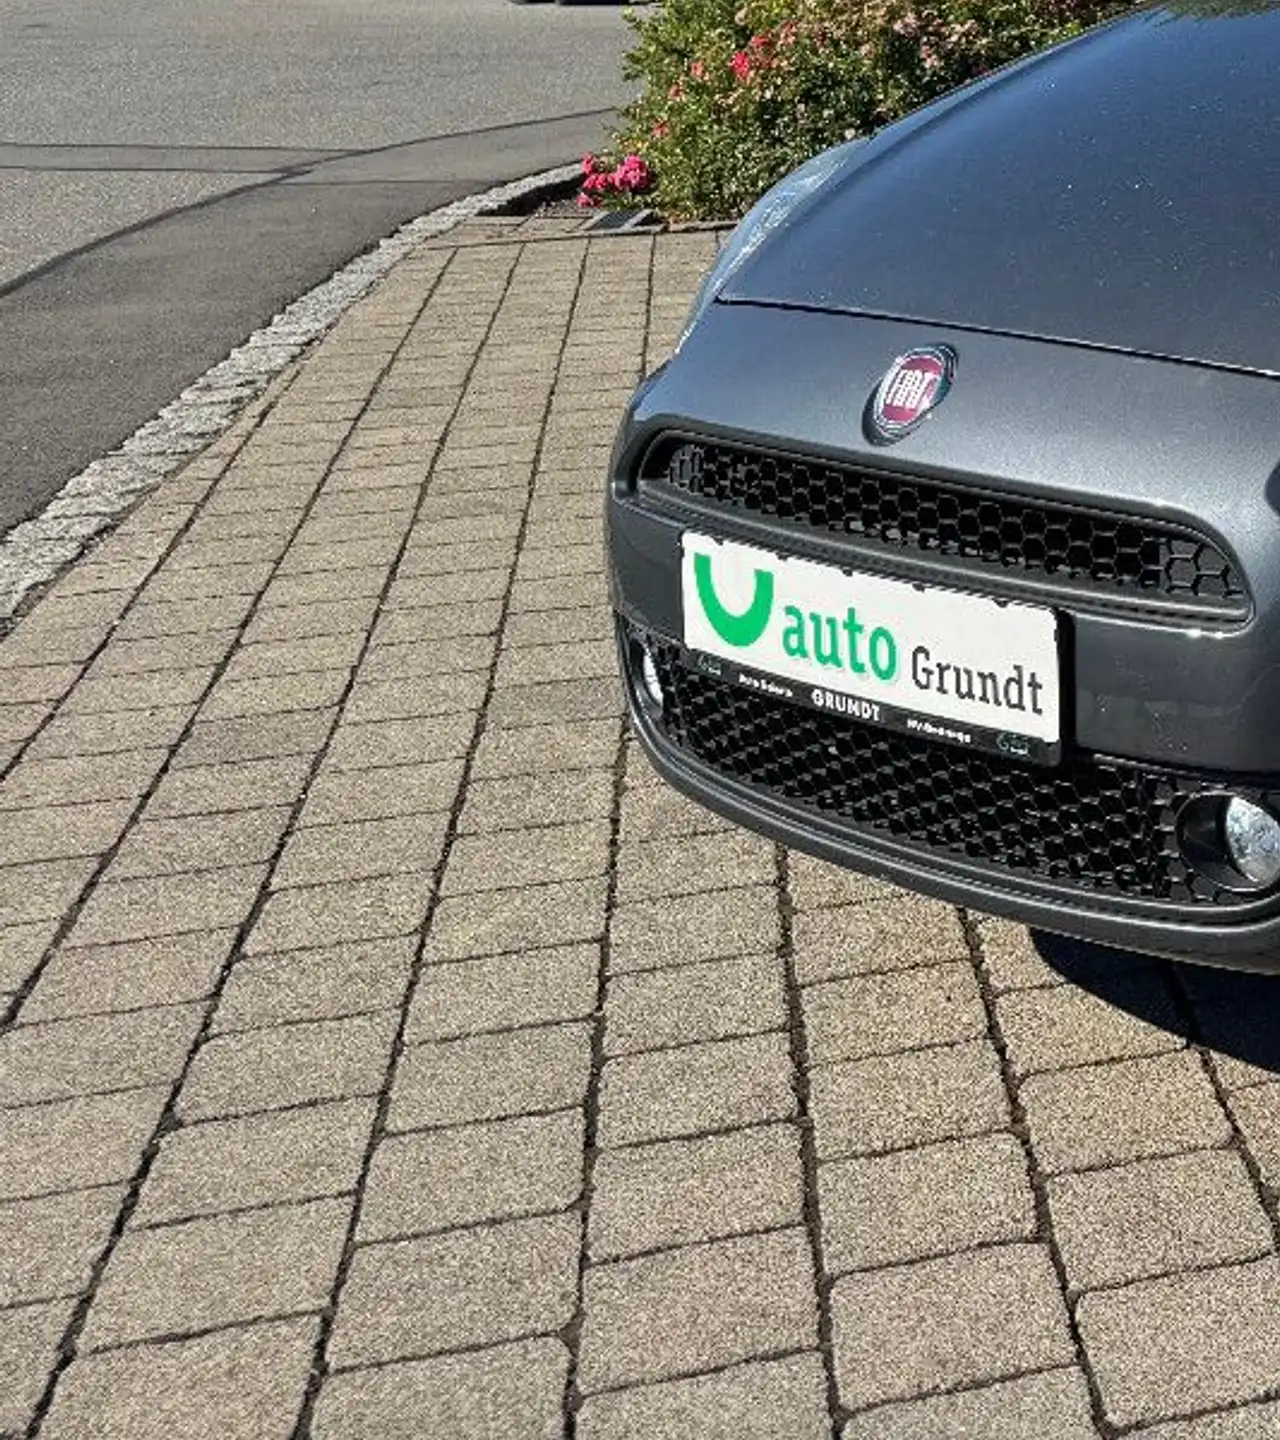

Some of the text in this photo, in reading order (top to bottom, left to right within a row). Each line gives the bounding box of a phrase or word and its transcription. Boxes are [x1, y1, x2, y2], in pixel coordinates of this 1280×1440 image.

[782, 604, 1043, 715] auto Grundt
[811, 688, 881, 722] GRUNDT
